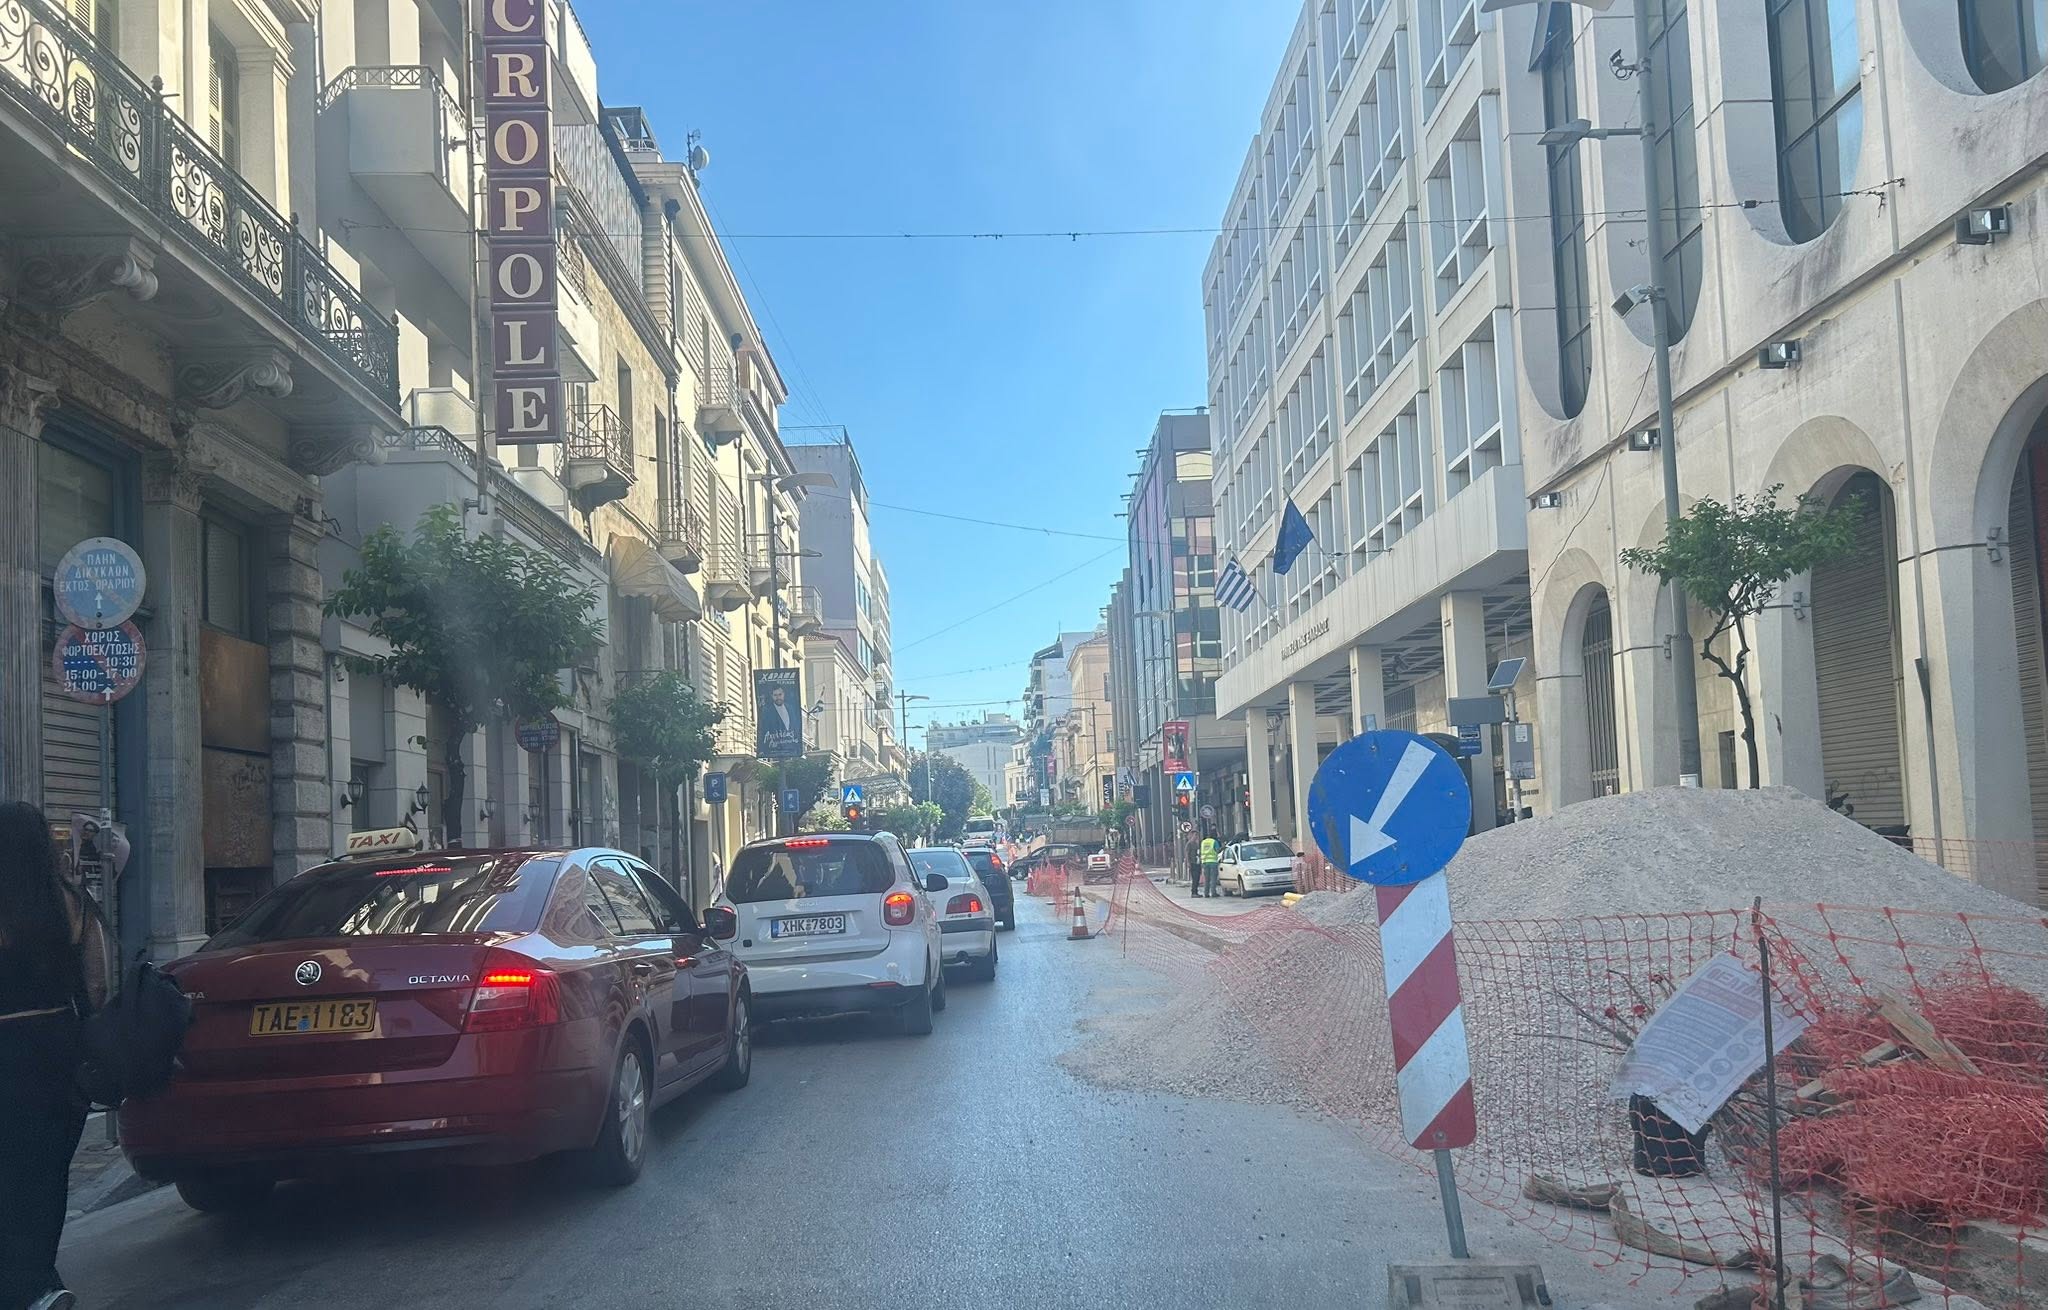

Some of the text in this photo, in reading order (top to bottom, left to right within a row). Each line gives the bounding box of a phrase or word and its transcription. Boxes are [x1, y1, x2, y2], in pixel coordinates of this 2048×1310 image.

[87, 552, 116, 565] ΠΛΗΝ
[75, 565, 129, 579] ΔΙΚΥΚΛΩΝ
[59, 578, 136, 592] ΕΚΤΟΣ ΩΡΑΡΙΟΥ
[84, 631, 120, 643] ΧΩΡΟΣ
[62, 643, 140, 656] ΦΟΡΤΟΕΚ/ΤΩΣΗΣ
[349, 832, 401, 849] TAXI
[408, 974, 471, 984] OCTAVIA
